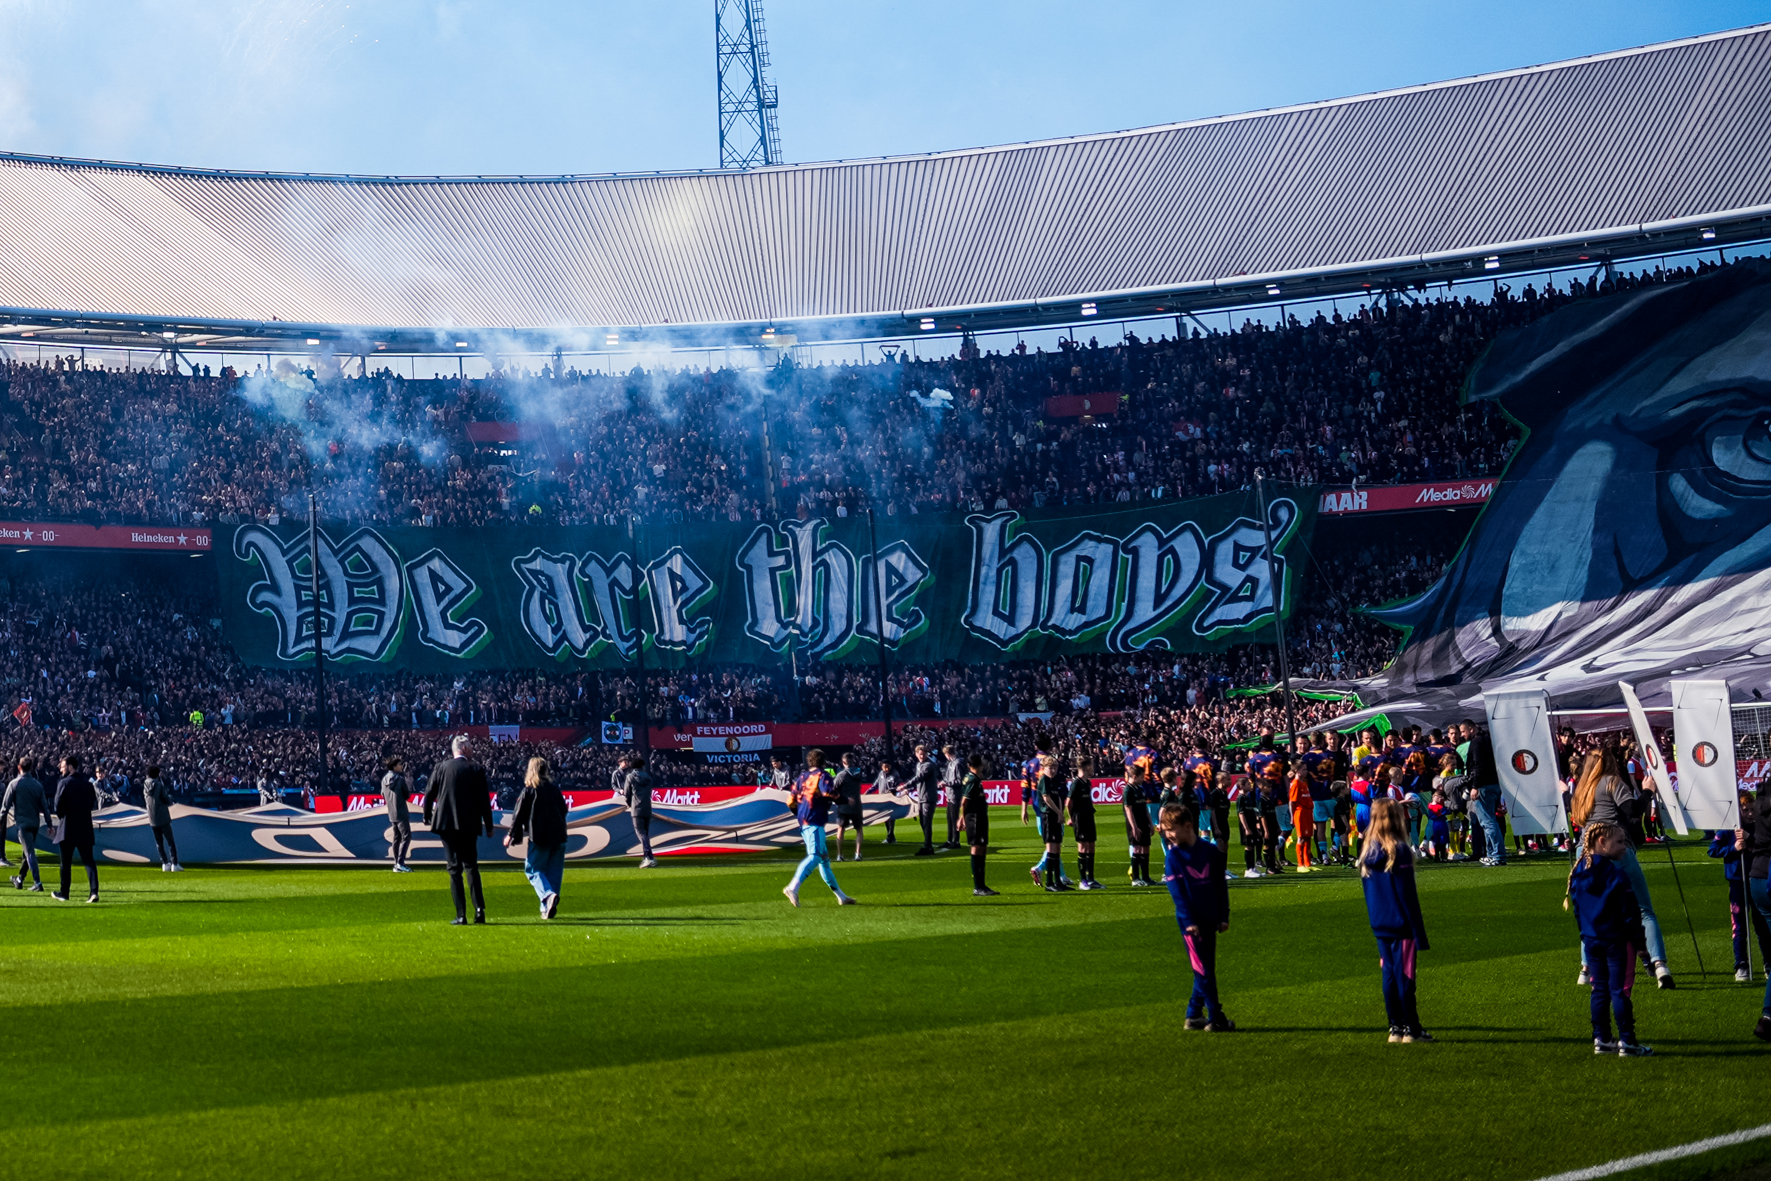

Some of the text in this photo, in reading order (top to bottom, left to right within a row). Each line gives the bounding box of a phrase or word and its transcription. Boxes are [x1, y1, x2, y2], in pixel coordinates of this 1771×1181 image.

[1415, 487, 1460, 504] Media
[131, 532, 175, 544] Heineken
[511, 545, 714, 661] are
[737, 516, 928, 657] the
[962, 498, 1297, 653] boys
[696, 724, 766, 735] FEYENOORD
[706, 753, 762, 764] VICTORIA
